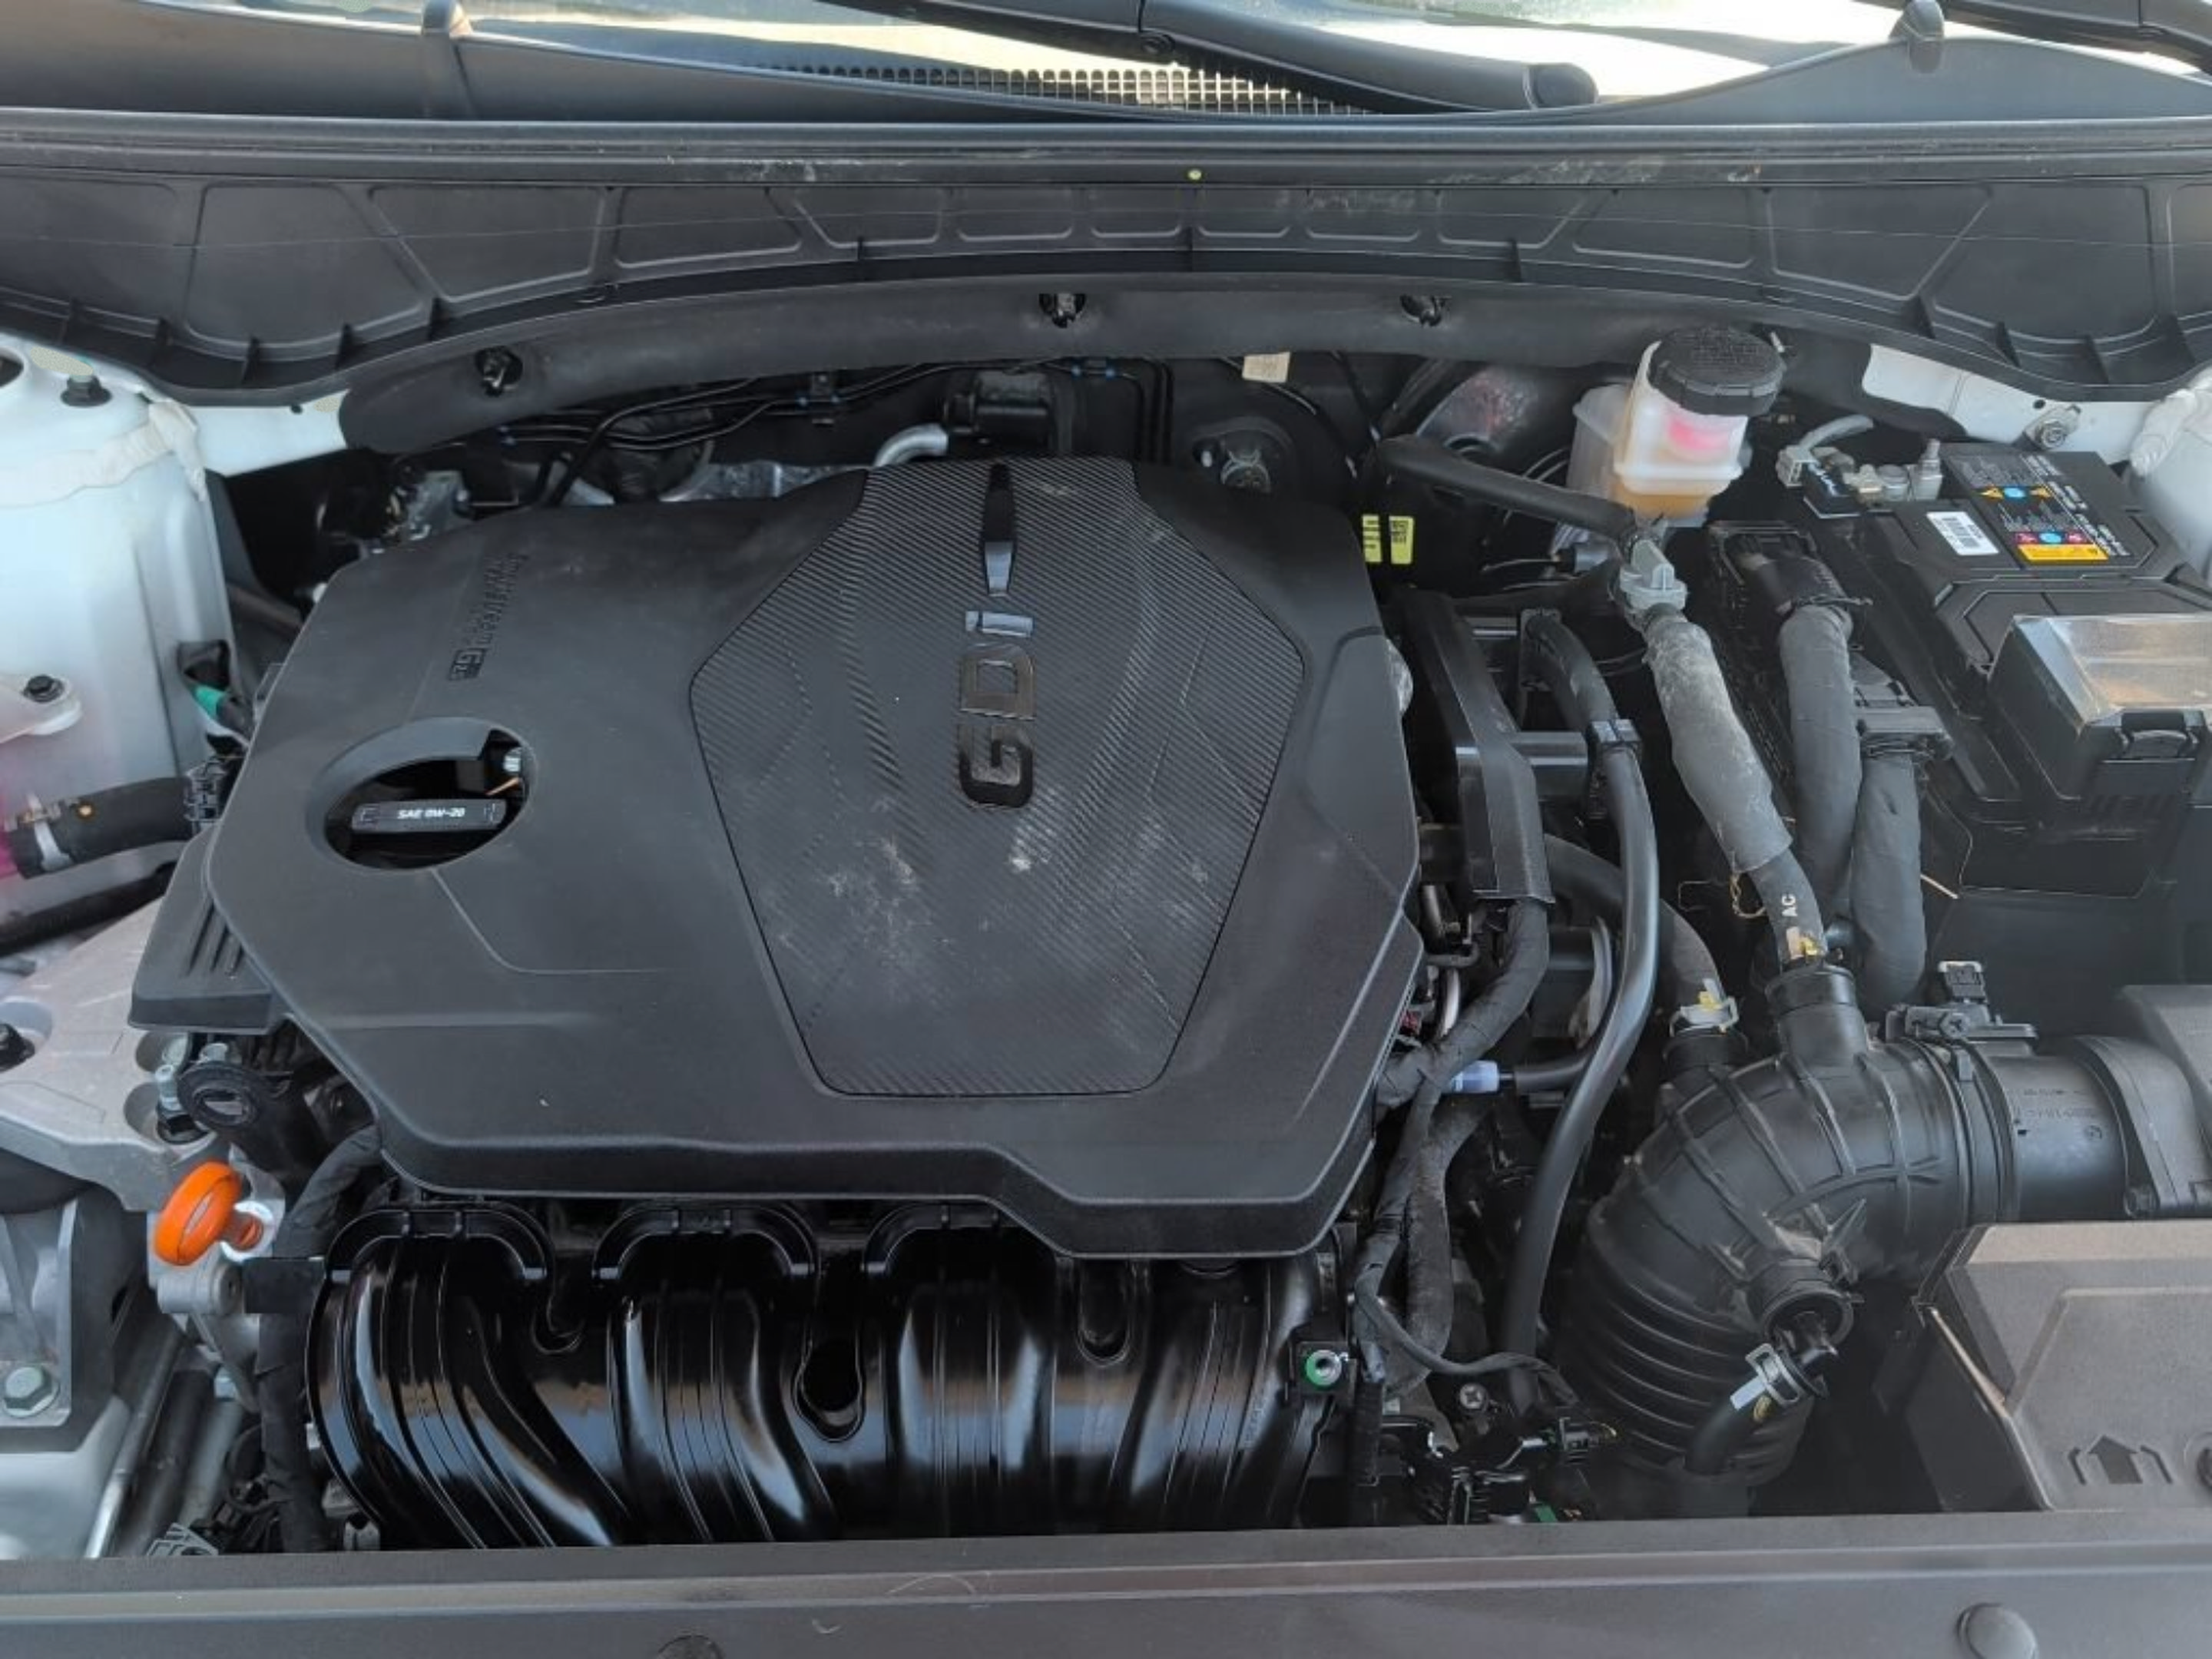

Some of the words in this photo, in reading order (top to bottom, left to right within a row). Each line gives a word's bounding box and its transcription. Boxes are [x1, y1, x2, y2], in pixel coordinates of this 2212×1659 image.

[397, 809, 424, 820] SAE
[424, 807, 465, 818] 0W-20
[1782, 894, 1798, 917] AC
